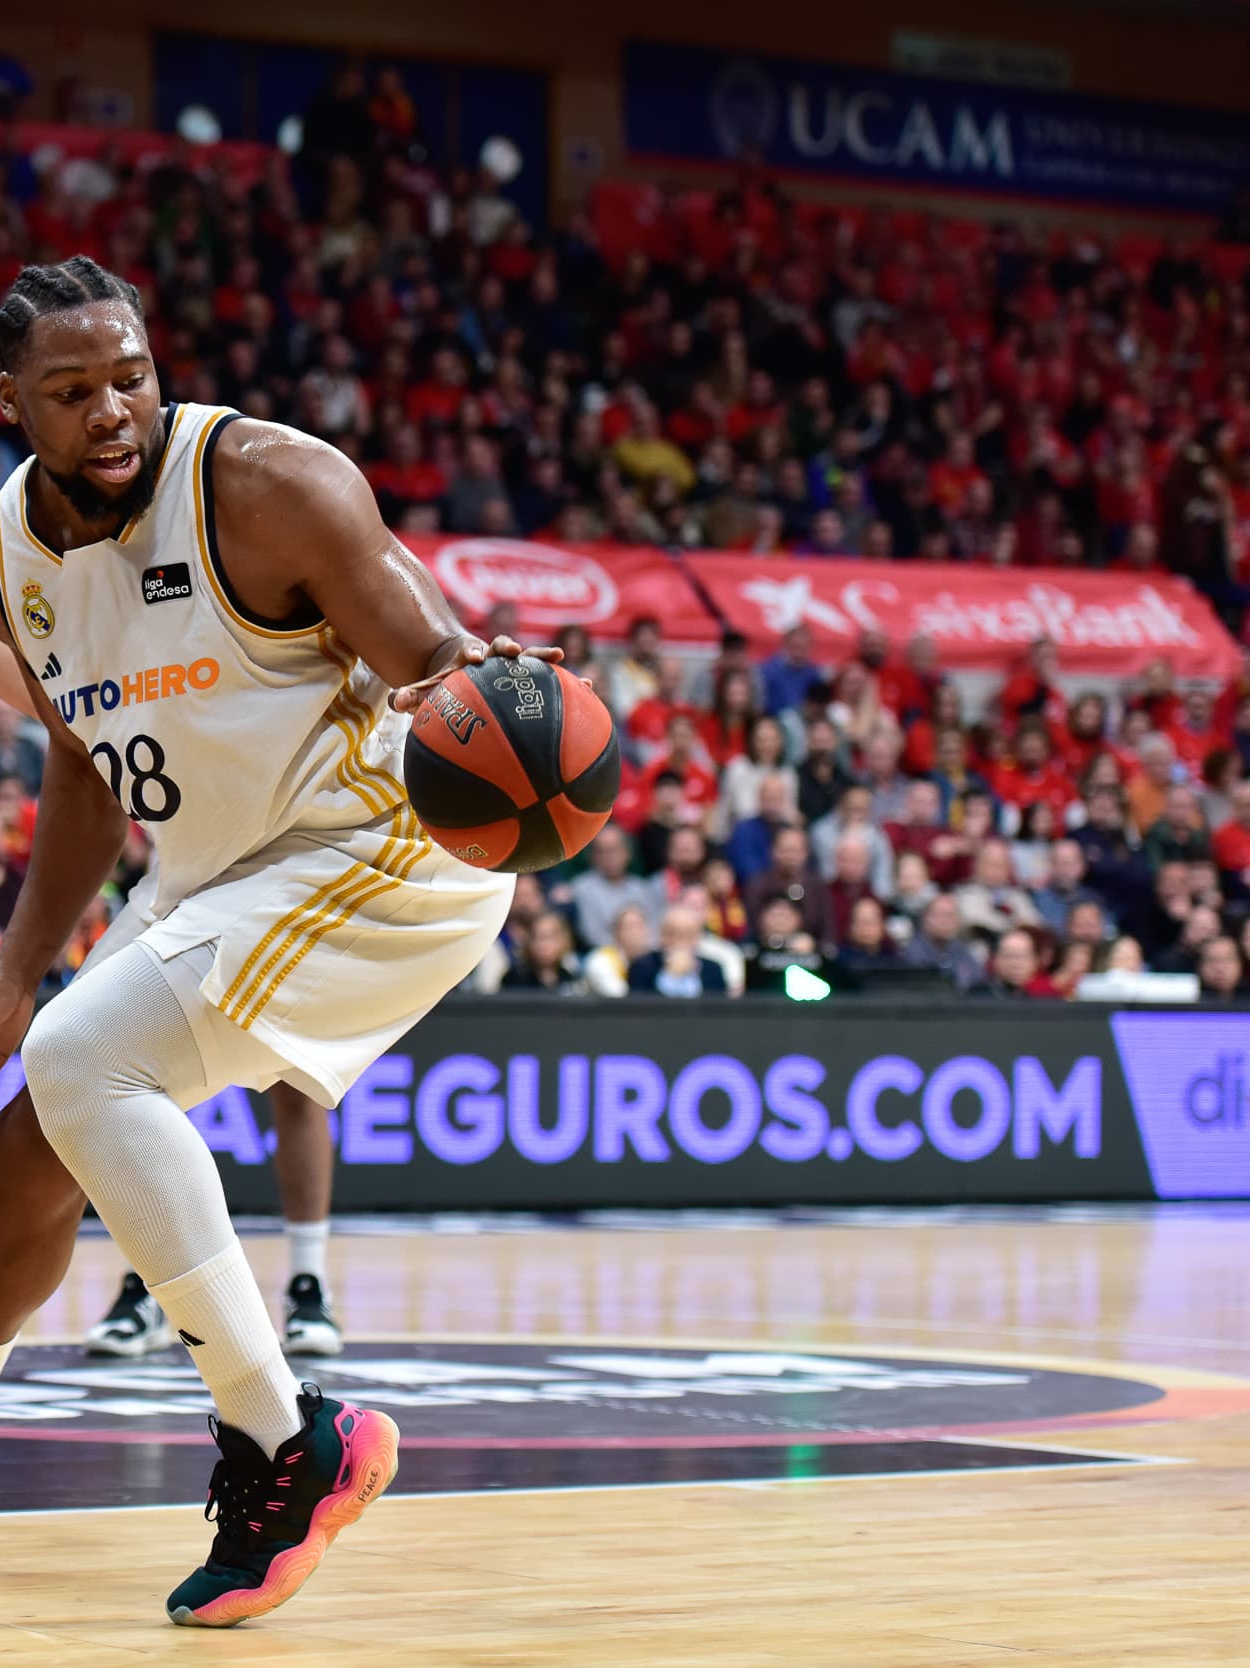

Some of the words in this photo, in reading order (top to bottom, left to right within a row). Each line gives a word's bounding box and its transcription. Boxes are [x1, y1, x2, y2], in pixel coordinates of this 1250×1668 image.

[788, 83, 1015, 177] UCAM
[144, 576, 163, 591] liga
[146, 583, 190, 600] endesa
[52, 657, 221, 723] UTOHERO
[357, 1470, 379, 1502] PEACE
